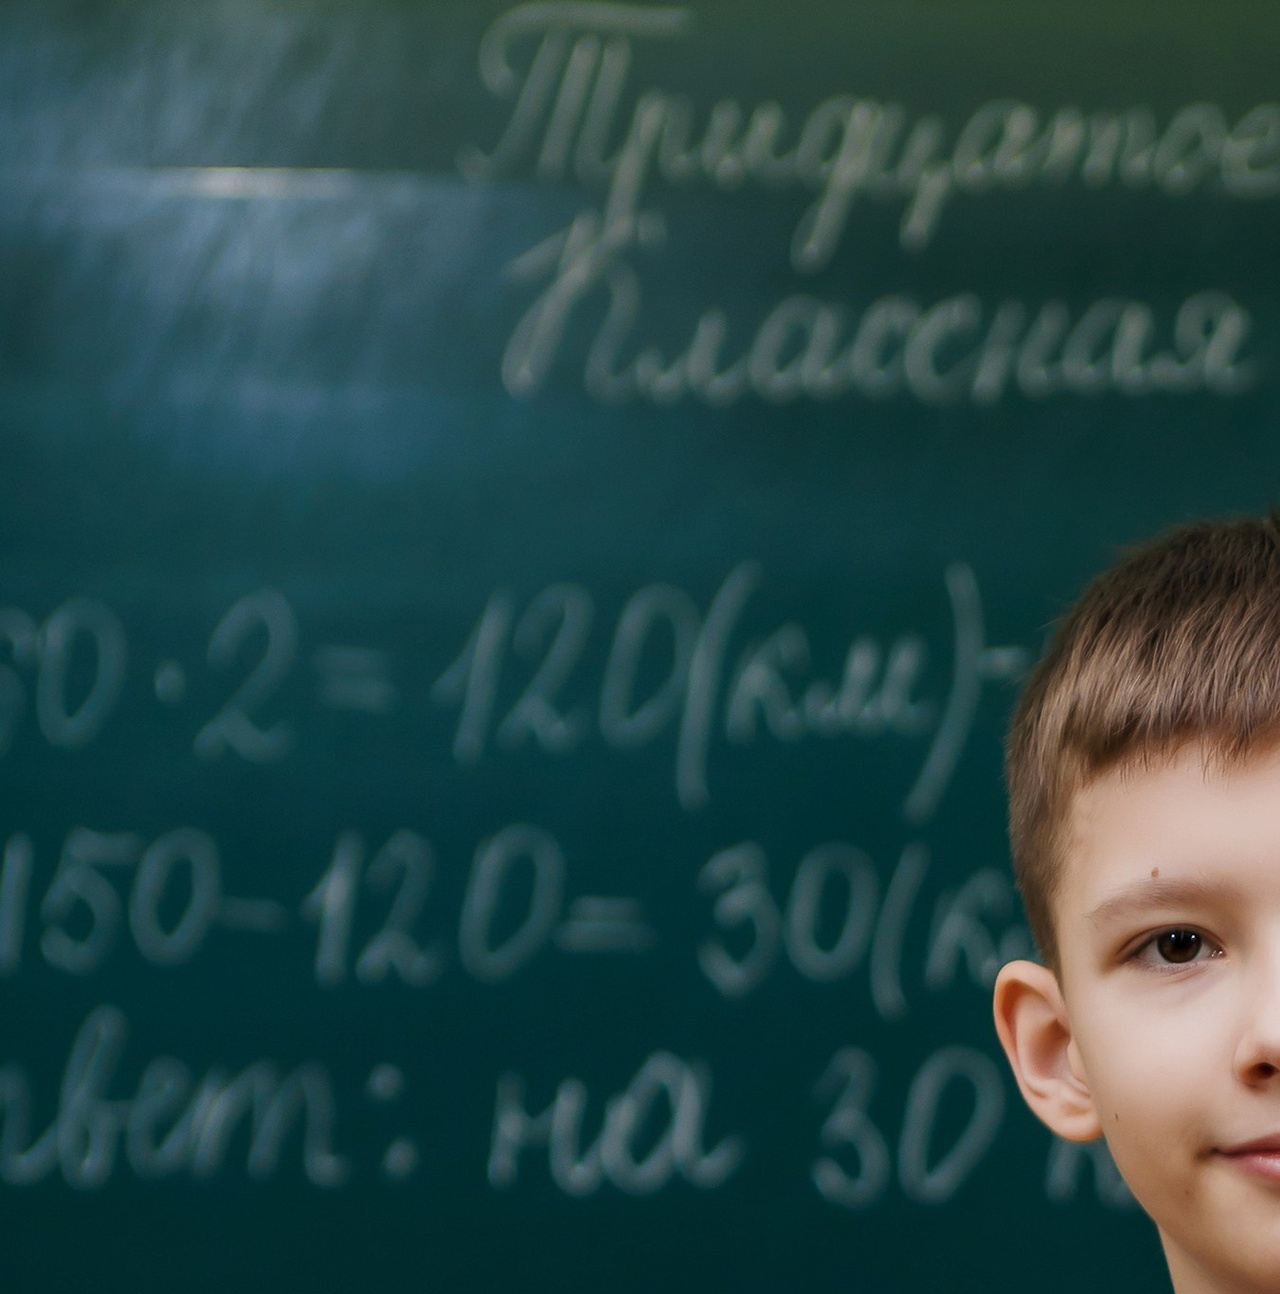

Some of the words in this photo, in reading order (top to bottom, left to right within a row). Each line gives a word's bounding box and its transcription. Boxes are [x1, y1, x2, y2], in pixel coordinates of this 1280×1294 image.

[500, 208, 1252, 402] Классная
[488, 1052, 745, 1196] на
[812, 1046, 1006, 1208] 30
